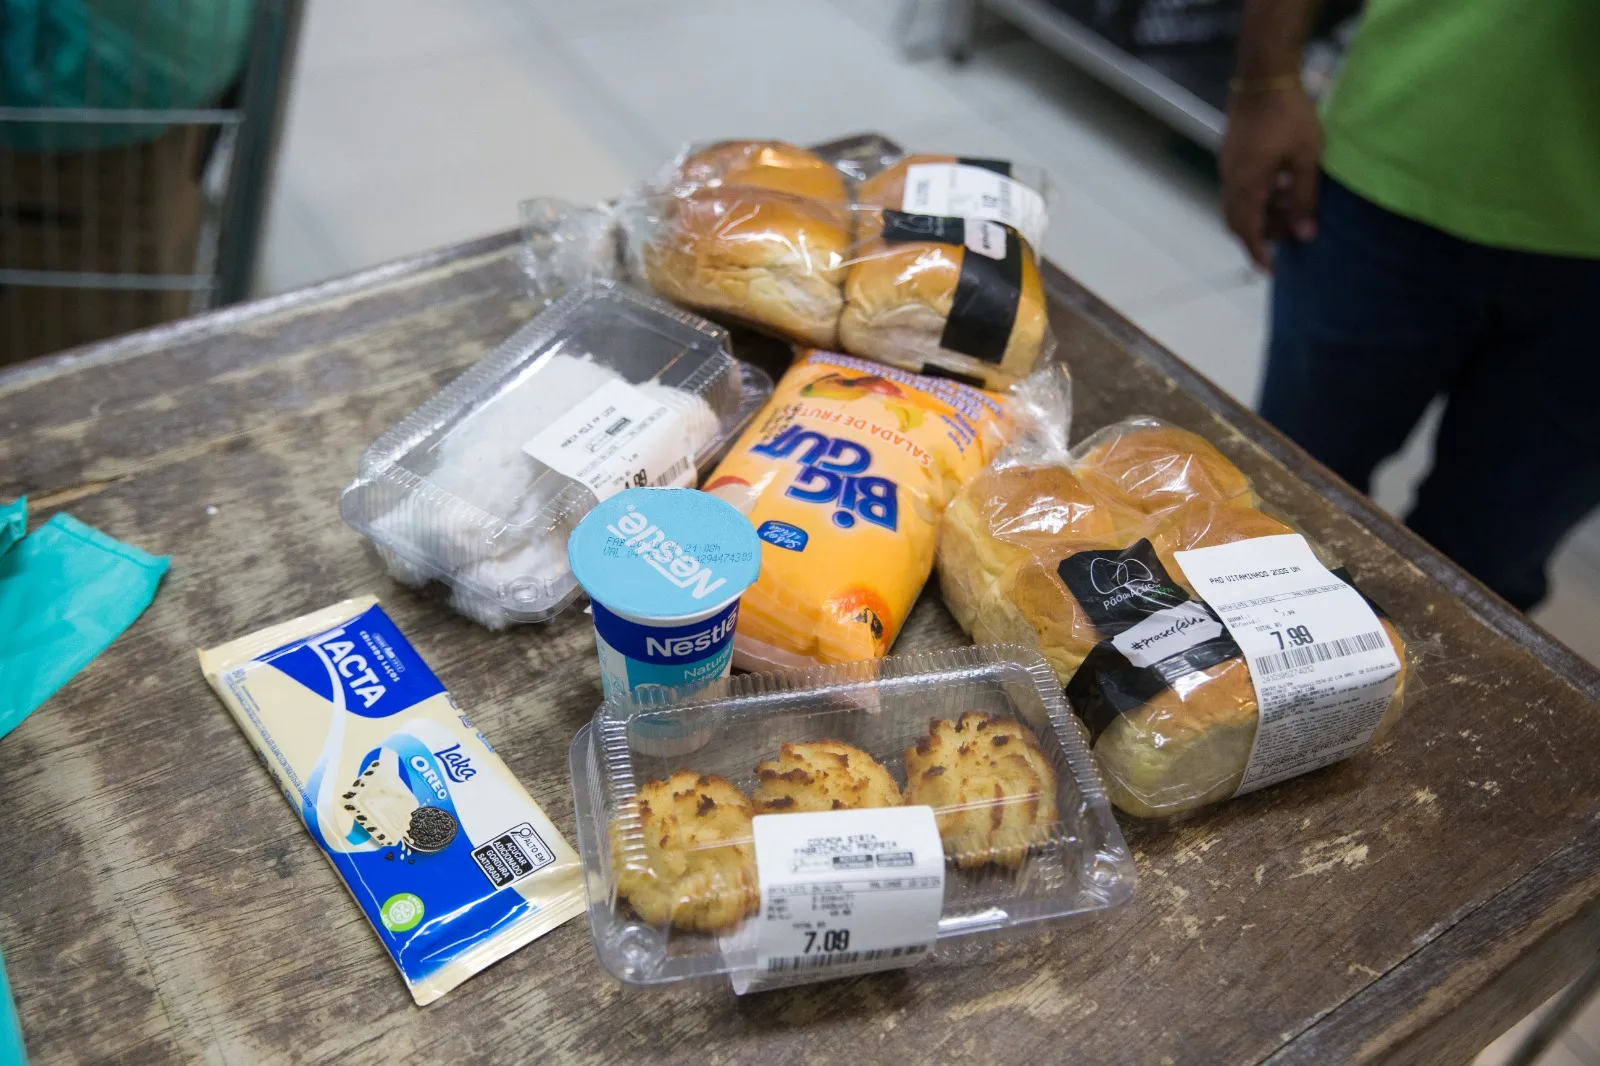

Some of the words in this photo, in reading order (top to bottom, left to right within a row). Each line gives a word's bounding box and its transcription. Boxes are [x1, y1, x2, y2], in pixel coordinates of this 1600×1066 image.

[844, 415, 868, 430] DE
[870, 425, 932, 465] SALADA
[606, 511, 727, 599] Nestlé
[1209, 575, 1224, 584] PAO
[1225, 570, 1269, 583] VITAMINADO
[646, 605, 738, 657] Nestlé
[1270, 624, 1314, 650] 7,99
[312, 626, 386, 708] LACTA
[359, 630, 385, 661] CRIANDO
[381, 661, 401, 682] LAÇOS
[410, 755, 448, 800] OREO
[434, 743, 477, 783] Laka
[477, 853, 503, 884] SATURADA
[486, 849, 510, 879] GORDURA
[493, 840, 524, 876] ADICIONADO
[524, 838, 539, 854] ALTO
[535, 852, 546, 863] EM
